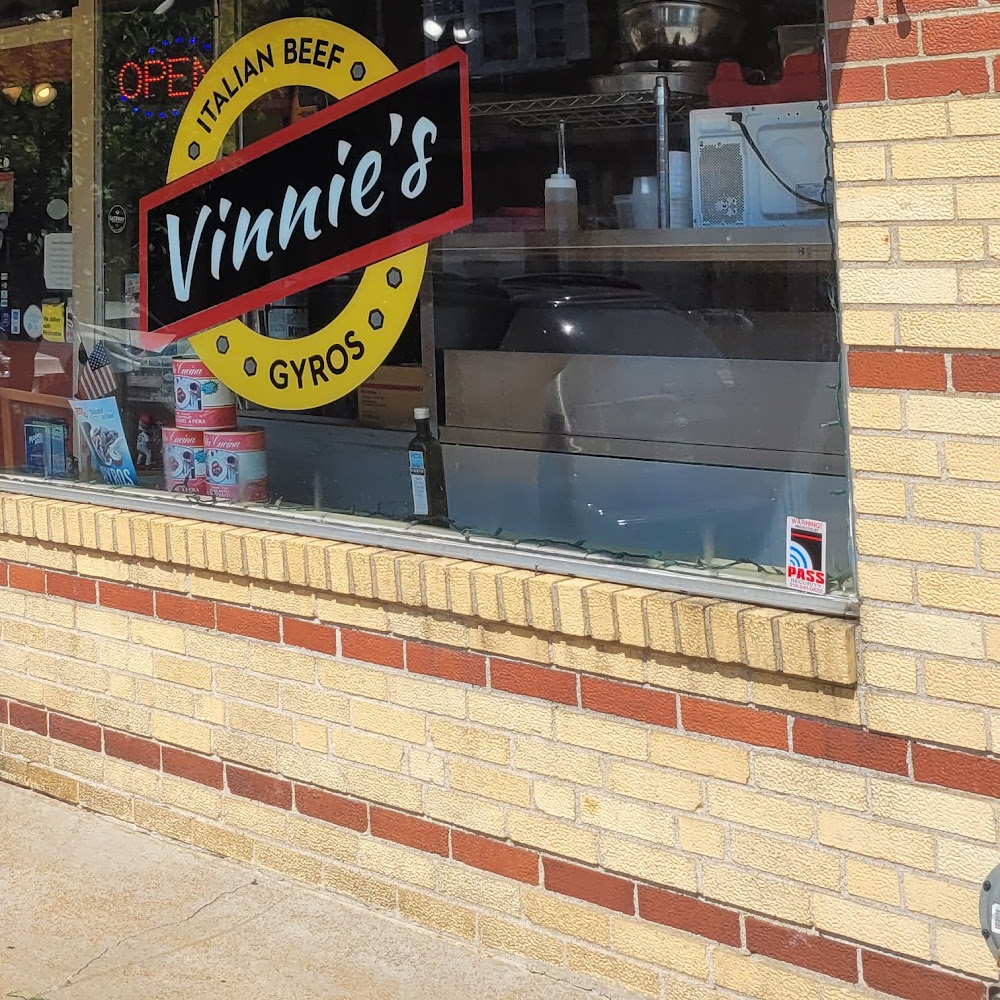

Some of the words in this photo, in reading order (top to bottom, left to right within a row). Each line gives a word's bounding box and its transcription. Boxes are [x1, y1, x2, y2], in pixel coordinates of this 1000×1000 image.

[196, 43, 275, 134] ITALIAN
[284, 37, 345, 70] BEEF
[166, 112, 437, 302] Vinnie's
[268, 330, 365, 390] GYROS
[787, 566, 825, 585] PASS
[790, 578, 822, 589] SECURITY
